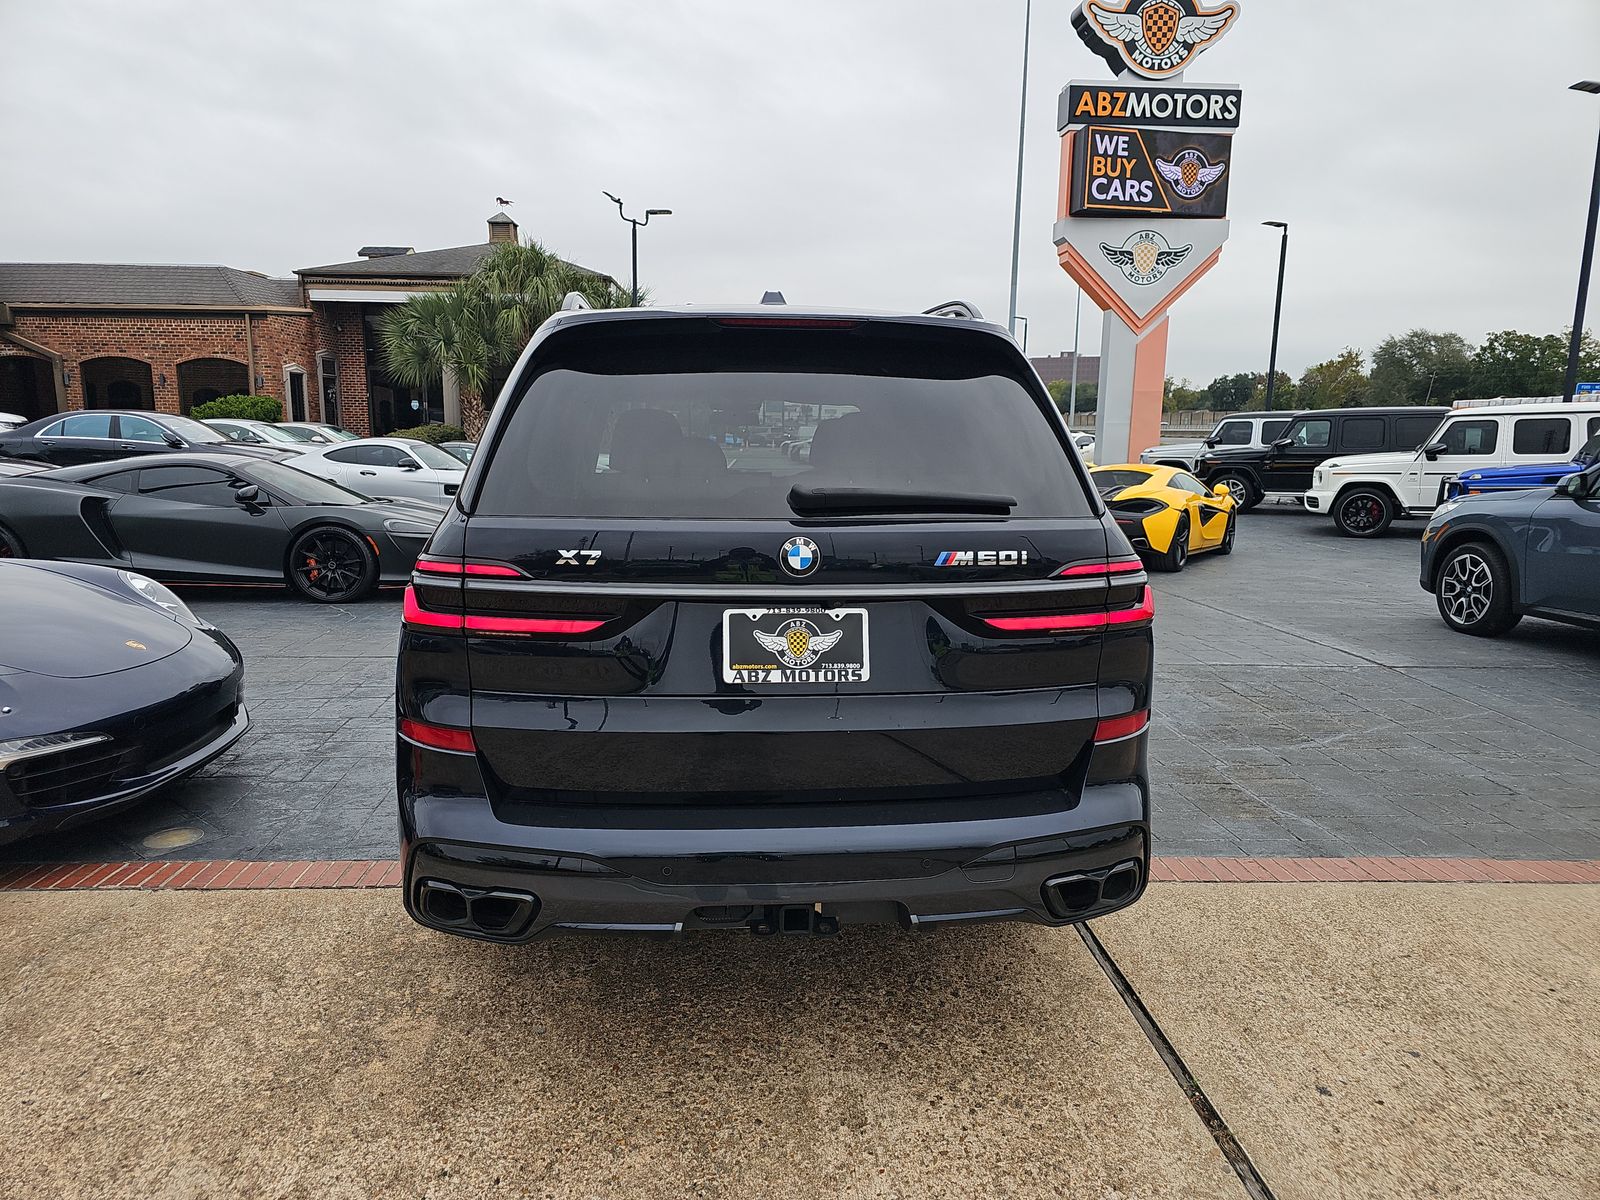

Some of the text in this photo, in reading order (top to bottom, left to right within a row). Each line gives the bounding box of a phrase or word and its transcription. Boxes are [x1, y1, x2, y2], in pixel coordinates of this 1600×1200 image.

[1131, 47, 1189, 70] MOTORS
[1095, 134, 1130, 156] WE
[1092, 157, 1137, 178] BUY
[1091, 179, 1153, 203] CARS
[1177, 184, 1203, 195] MOTORS
[1127, 269, 1163, 283] MOTORS
[784, 538, 817, 551] BMW
[555, 549, 602, 565] X7
[790, 620, 807, 628] ABZ
[782, 653, 816, 666] MOTORS
[732, 669, 862, 683] ABZ MOTORS
